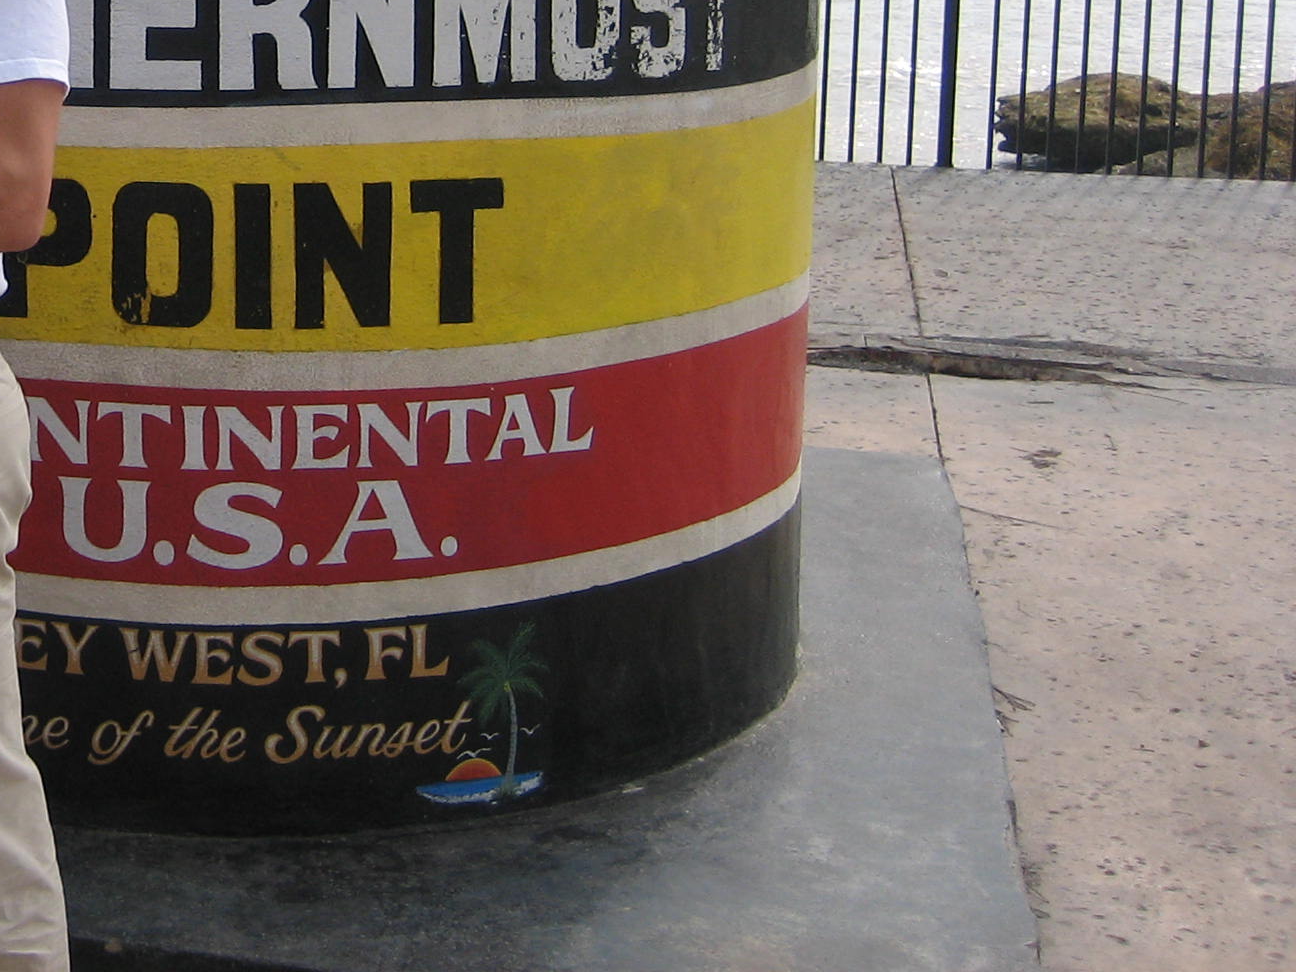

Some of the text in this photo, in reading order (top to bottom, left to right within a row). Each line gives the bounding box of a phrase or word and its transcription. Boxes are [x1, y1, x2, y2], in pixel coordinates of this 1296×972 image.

[25, 386, 594, 470] NTINENTAL
[58, 476, 458, 571] U.S.A.
[118, 628, 347, 688] WEST,
[363, 624, 450, 681] FL
[88, 709, 154, 765] of
[163, 706, 246, 763] the
[264, 699, 473, 764] Sunset
